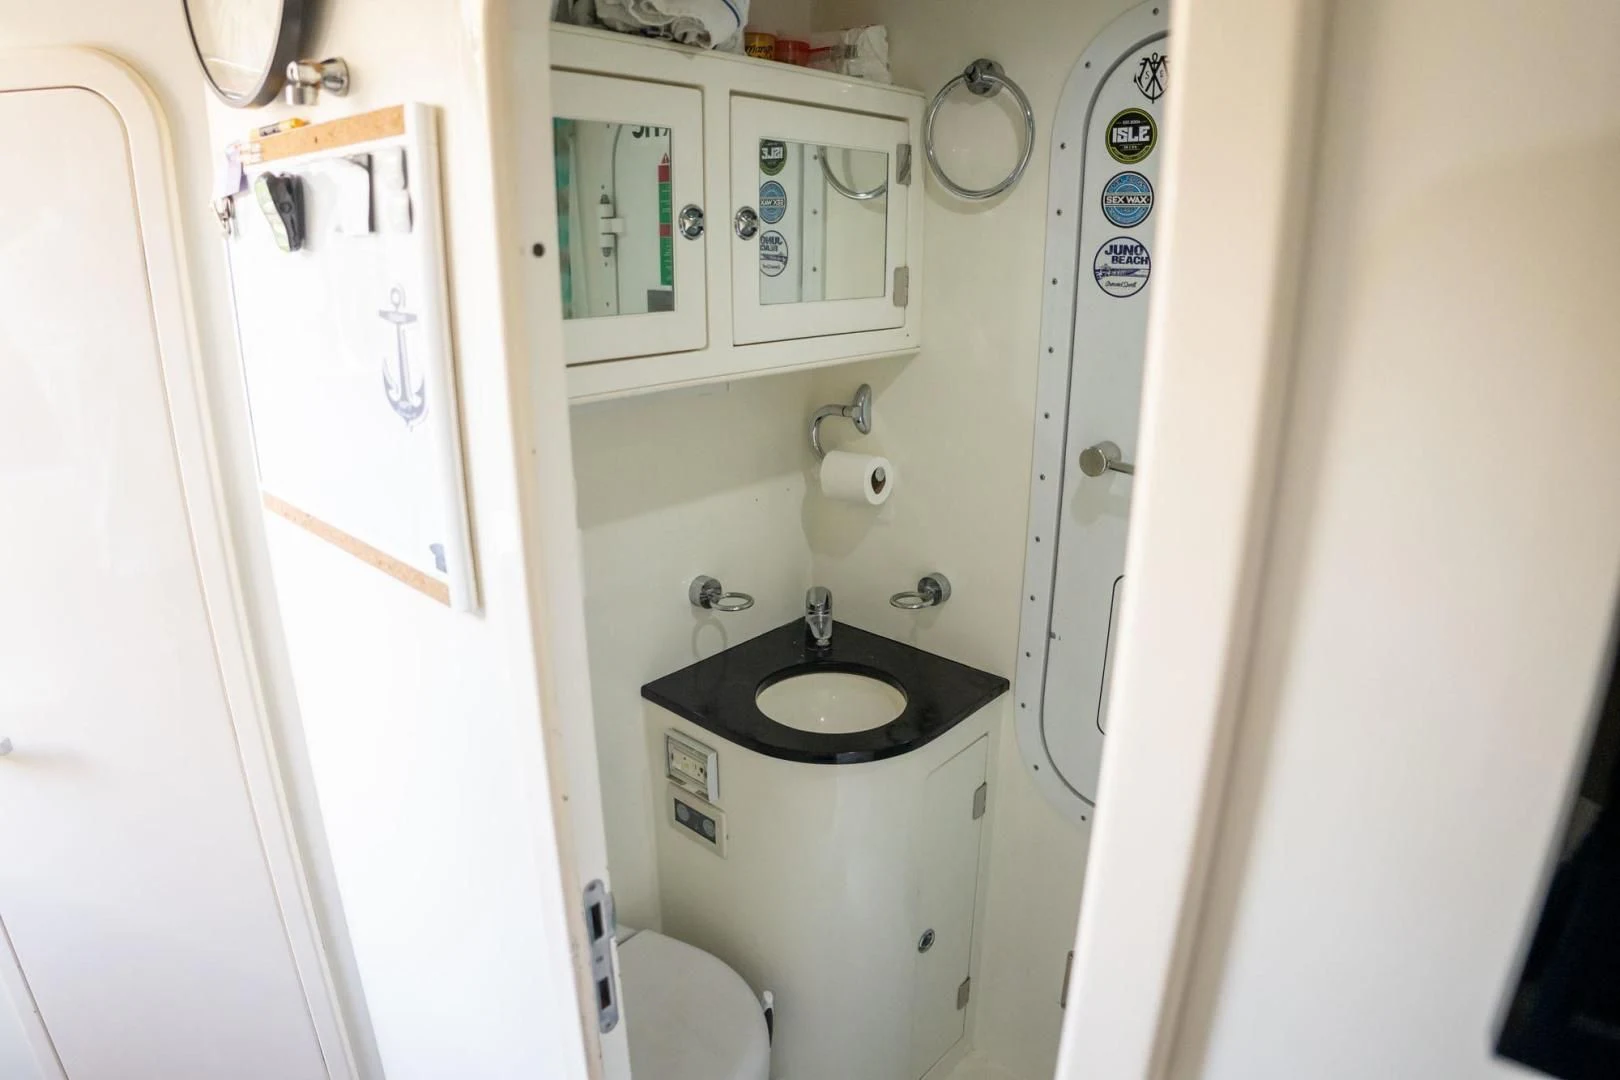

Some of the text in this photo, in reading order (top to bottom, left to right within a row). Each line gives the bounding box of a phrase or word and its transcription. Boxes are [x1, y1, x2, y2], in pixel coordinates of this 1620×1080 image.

[1112, 125, 1150, 143] ISLE
[1106, 195, 1147, 204] SEX WAX
[1104, 244, 1144, 256] JUNO
[1111, 255, 1149, 265] BEACH
